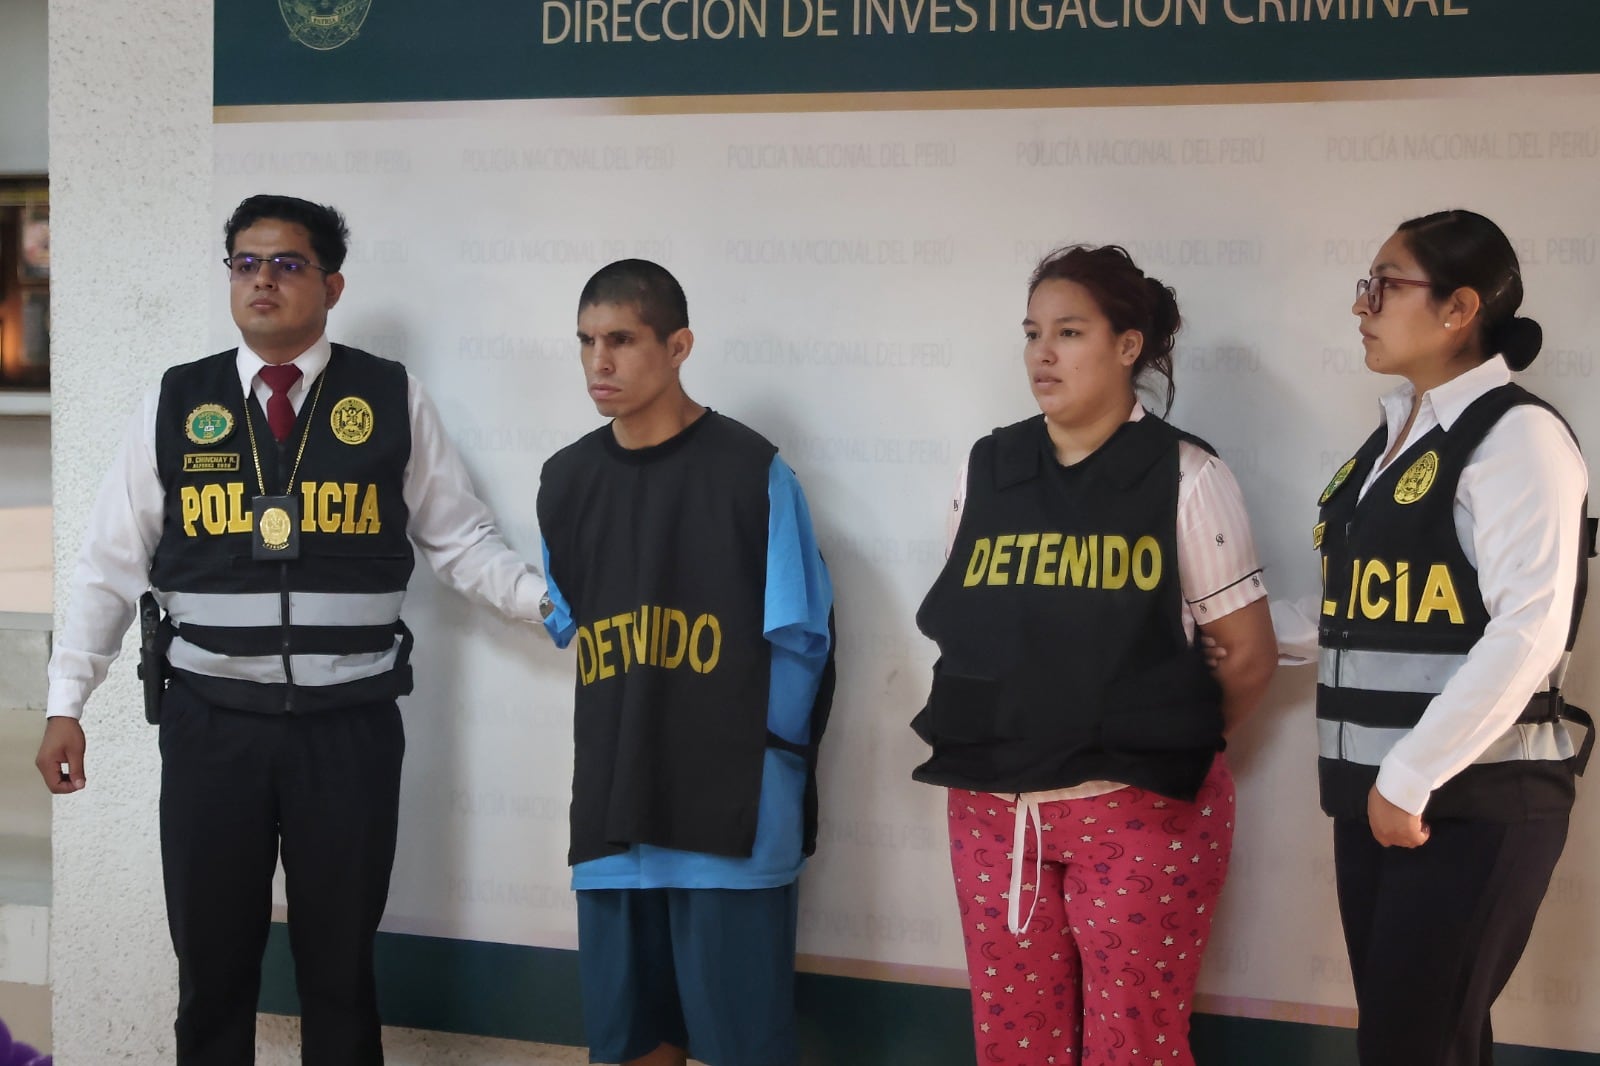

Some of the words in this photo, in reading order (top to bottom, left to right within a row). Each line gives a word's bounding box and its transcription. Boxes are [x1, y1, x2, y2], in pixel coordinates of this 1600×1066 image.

[782, 0, 839, 37] DE
[602, 146, 632, 170] DEL
[791, 143, 878, 169] NACIONAL
[880, 142, 911, 167] DEL
[1015, 136, 1082, 167] POLICÍA
[1086, 139, 1177, 166] NACIONAL
[1181, 138, 1216, 165] DEL
[1219, 134, 1266, 164] PERÚ
[1325, 130, 1398, 163] POLICÍA
[1402, 131, 1504, 161] NACIONAL
[1507, 131, 1544, 160] DEL
[1549, 125, 1599, 159] PERÚ
[790, 239, 876, 265] NACIONAL
[877, 240, 908, 265] DEL
[912, 234, 954, 265] PERÚ
[1178, 239, 1212, 265] DEL
[1546, 232, 1596, 264] PERÚ
[963, 533, 1162, 591] DETENIDO
